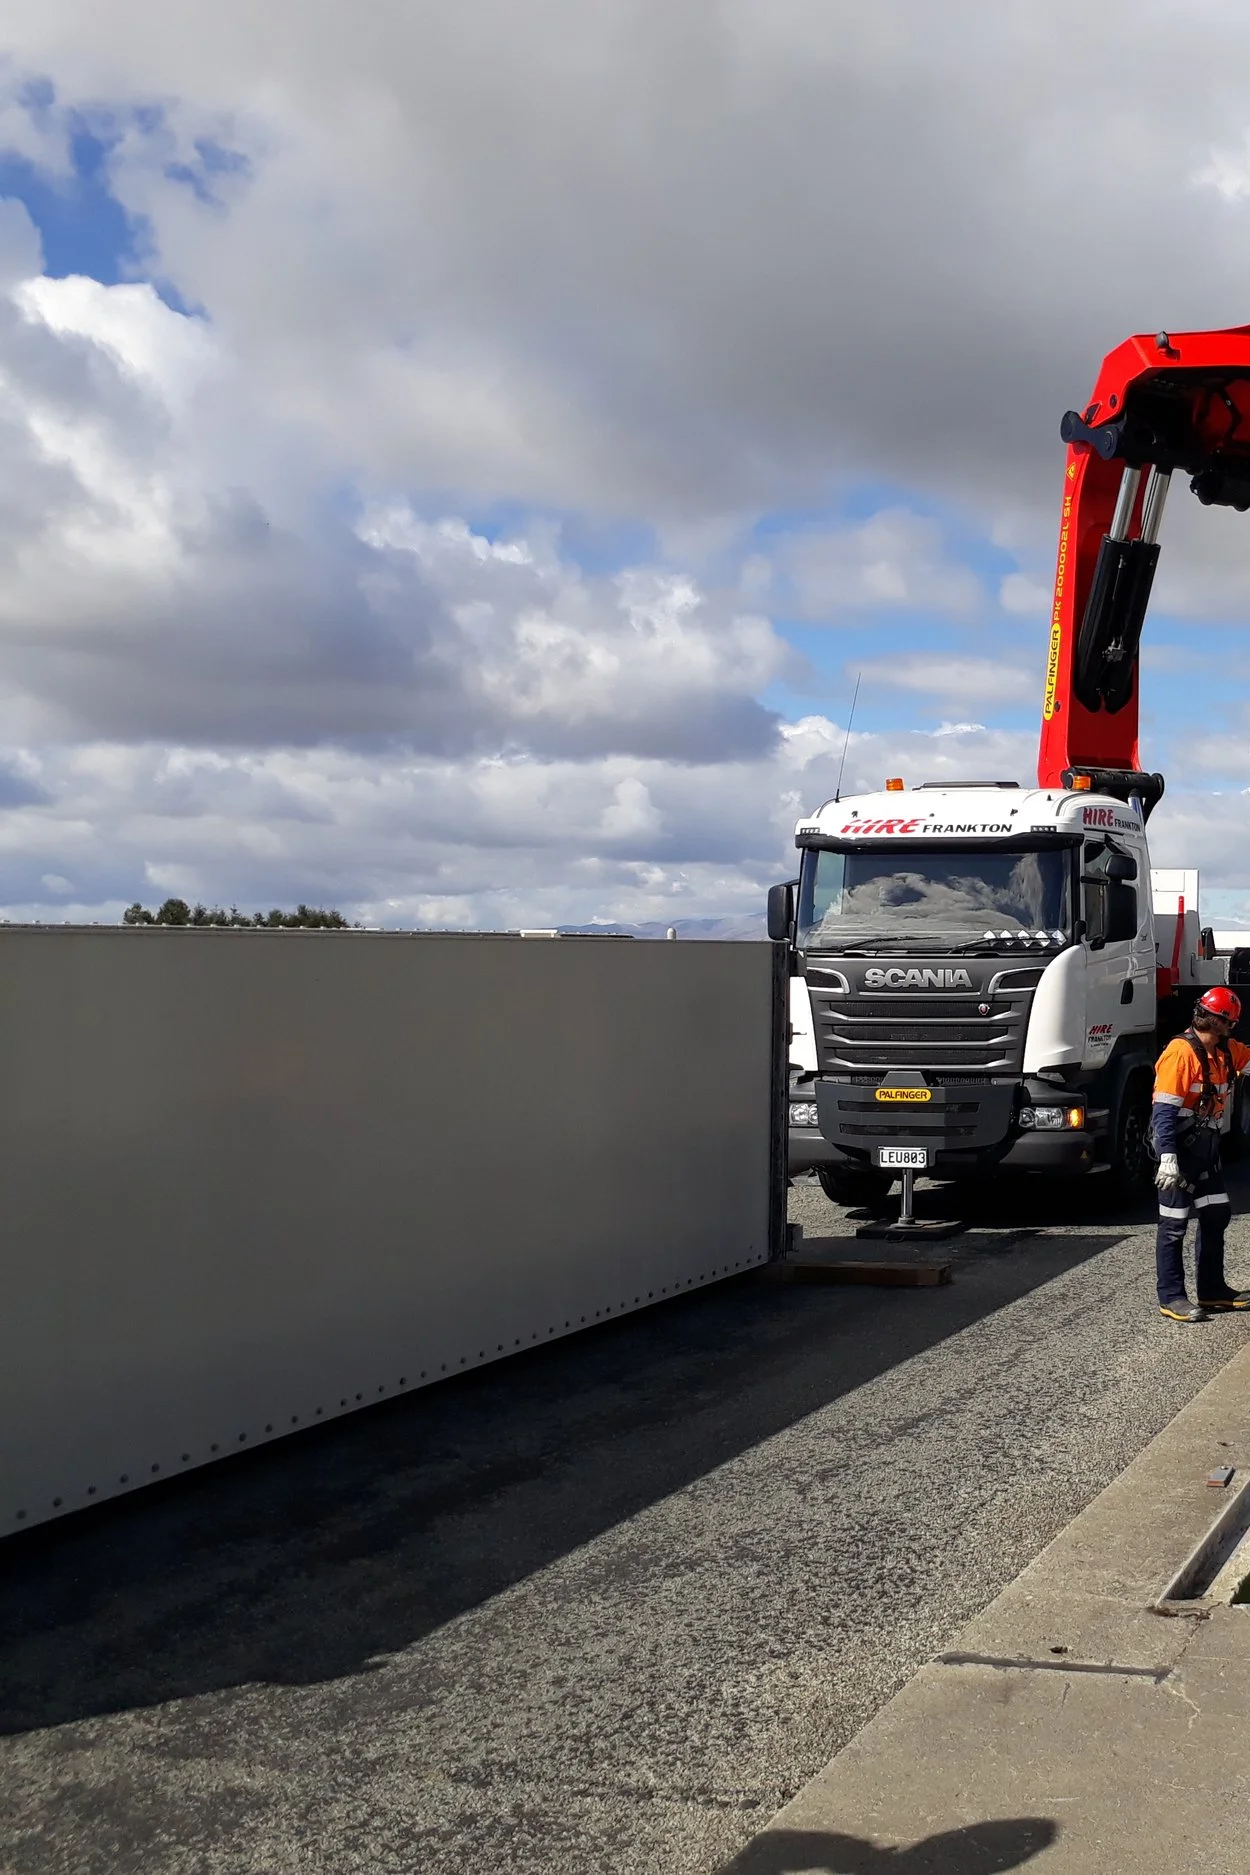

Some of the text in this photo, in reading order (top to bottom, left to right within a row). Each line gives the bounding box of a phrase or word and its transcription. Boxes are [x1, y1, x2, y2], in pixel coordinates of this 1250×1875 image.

[1045, 629, 1059, 714] PALFINGER
[1053, 601, 1062, 621] PK
[840, 818, 1012, 835] HIRE FRANKTON
[1083, 807, 1141, 832] HIRE FRANKTON
[864, 968, 973, 988] SCANIA
[1089, 1023, 1113, 1035] HIRE
[879, 1090, 928, 1099] PALFINGER
[880, 1151, 926, 1164] LEU803
